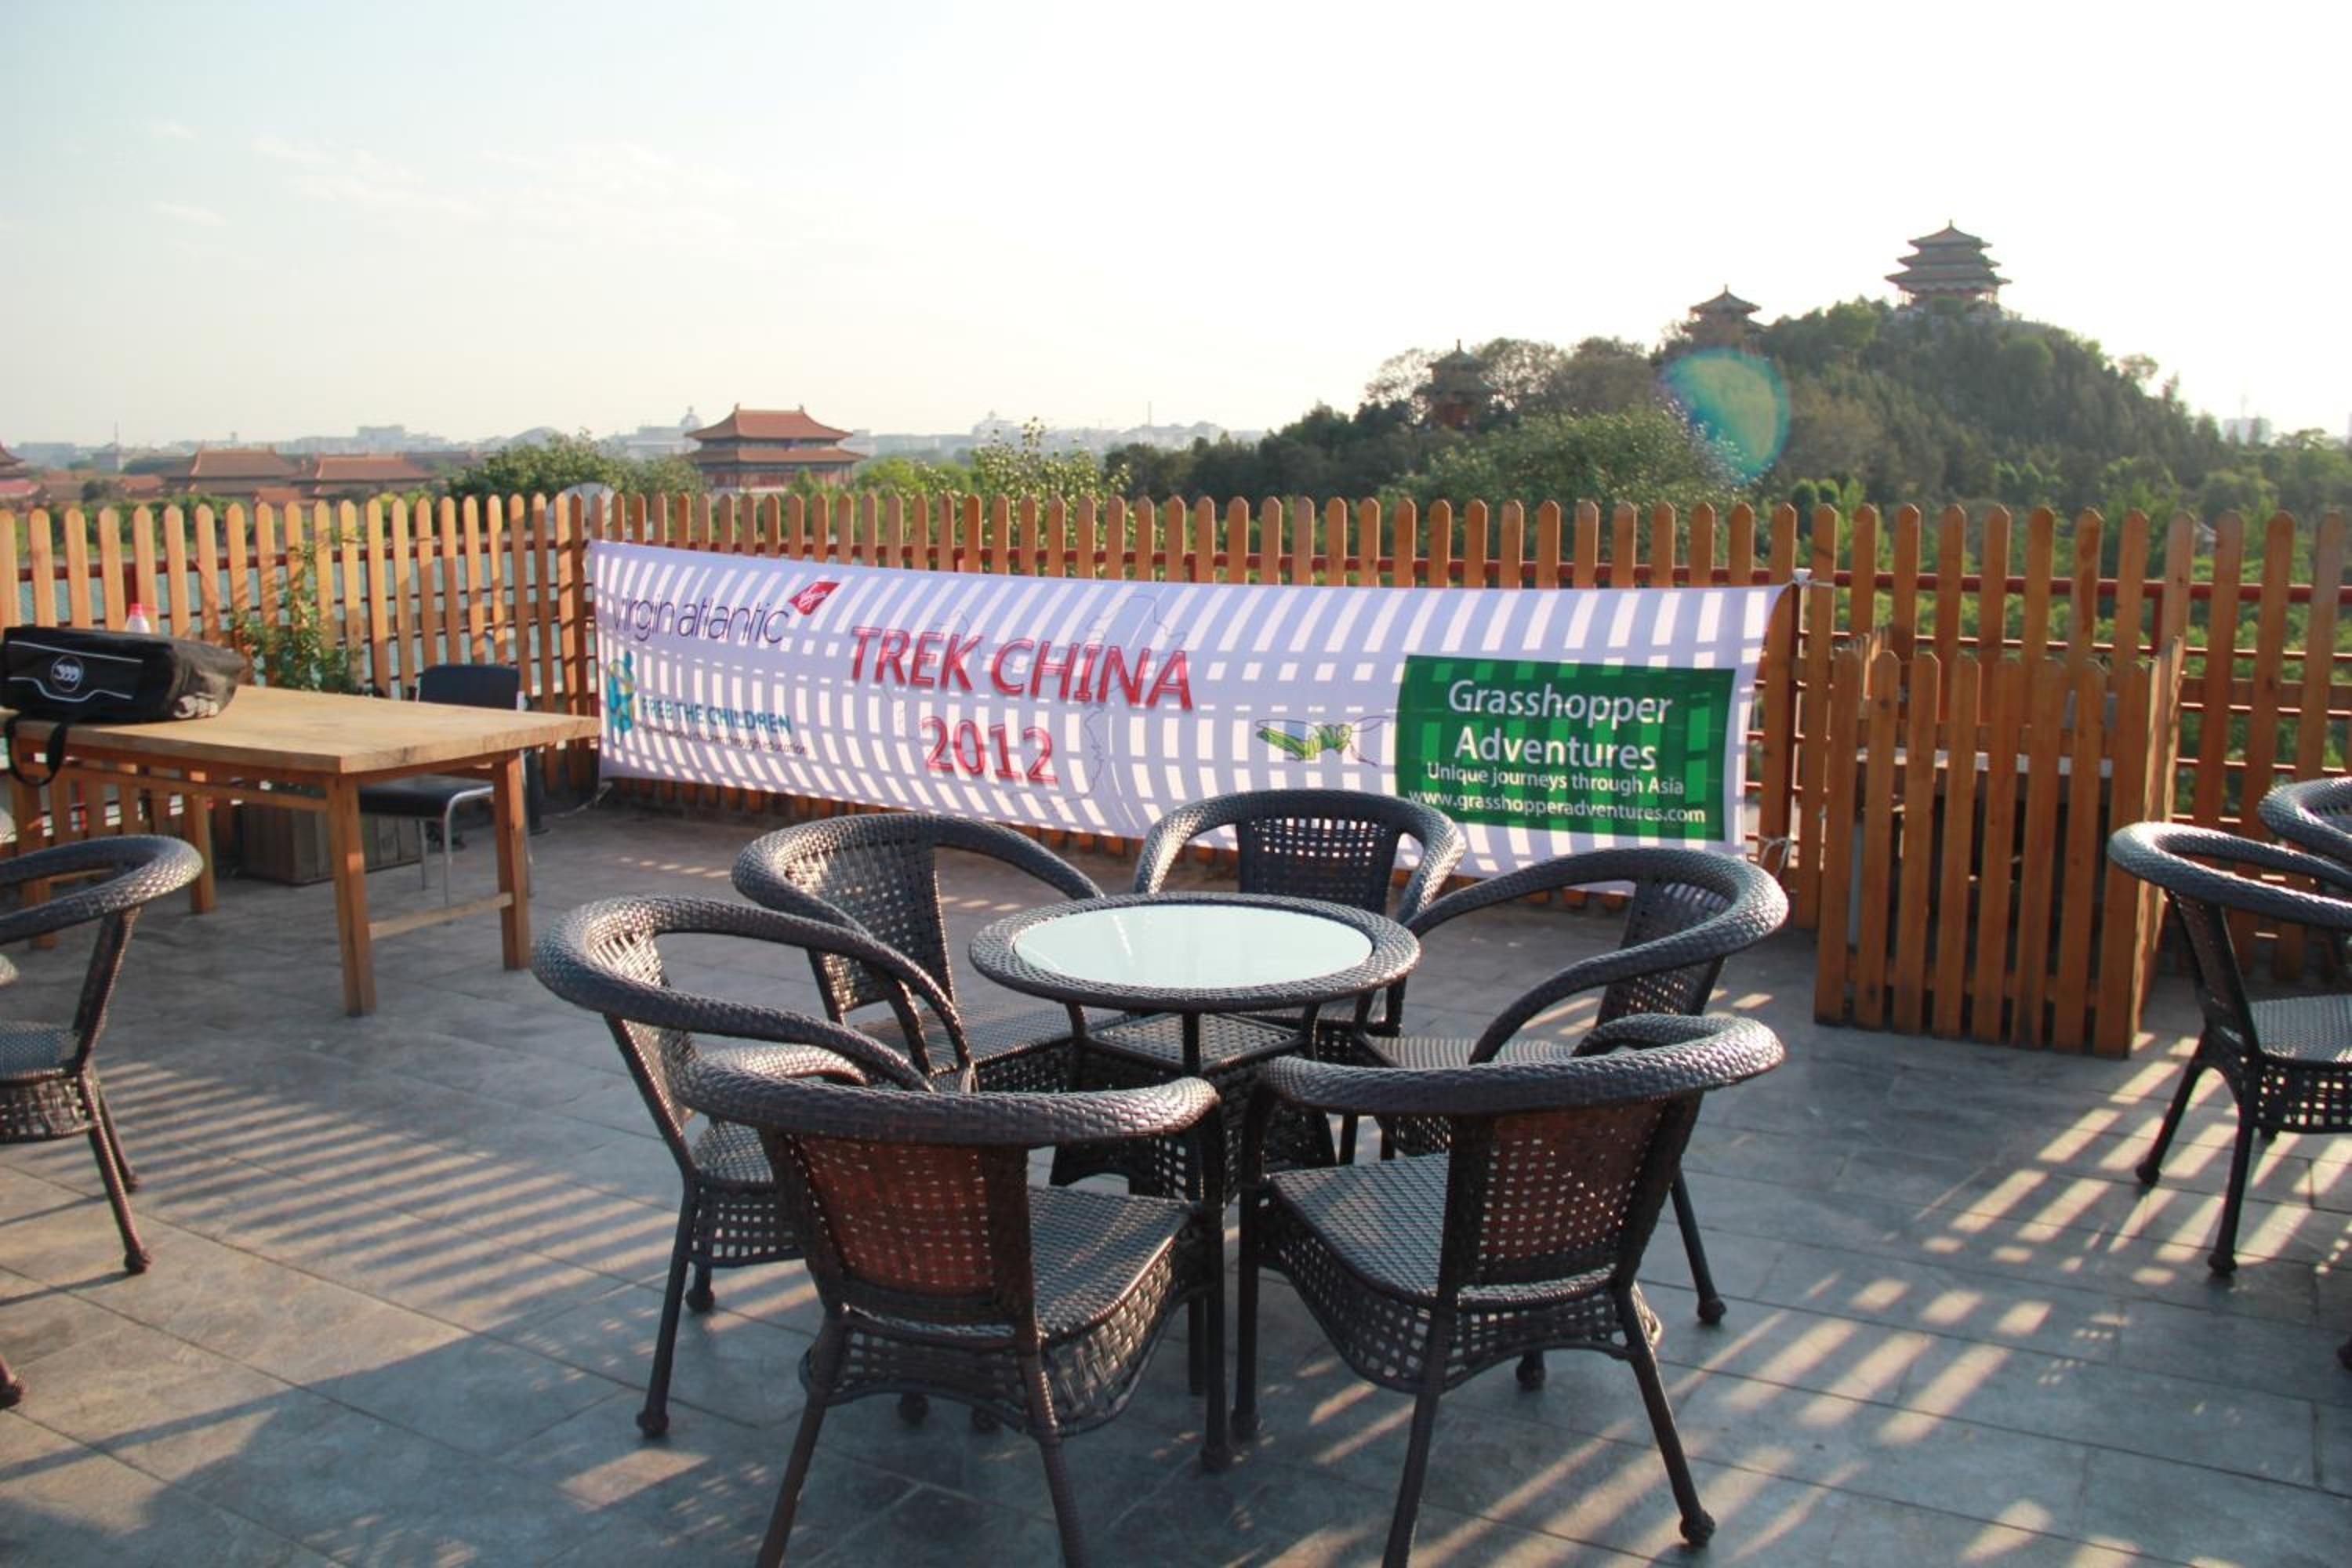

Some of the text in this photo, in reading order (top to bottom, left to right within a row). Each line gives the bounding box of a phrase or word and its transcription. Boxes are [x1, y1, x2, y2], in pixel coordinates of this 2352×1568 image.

[612, 594, 789, 644] virgin atlantic
[851, 626, 1193, 710] TREK CHINA
[641, 697, 673, 719] FREE
[675, 702, 703, 724] THE
[707, 706, 792, 735] CHILDREN
[1448, 679, 1674, 731] Grasshopper
[920, 716, 1058, 785] 2012
[1454, 725, 1657, 771] Adventures
[1427, 761, 1684, 797] Unique journeys through Asia
[1408, 790, 1706, 824] www.grasshopperadventures.com
